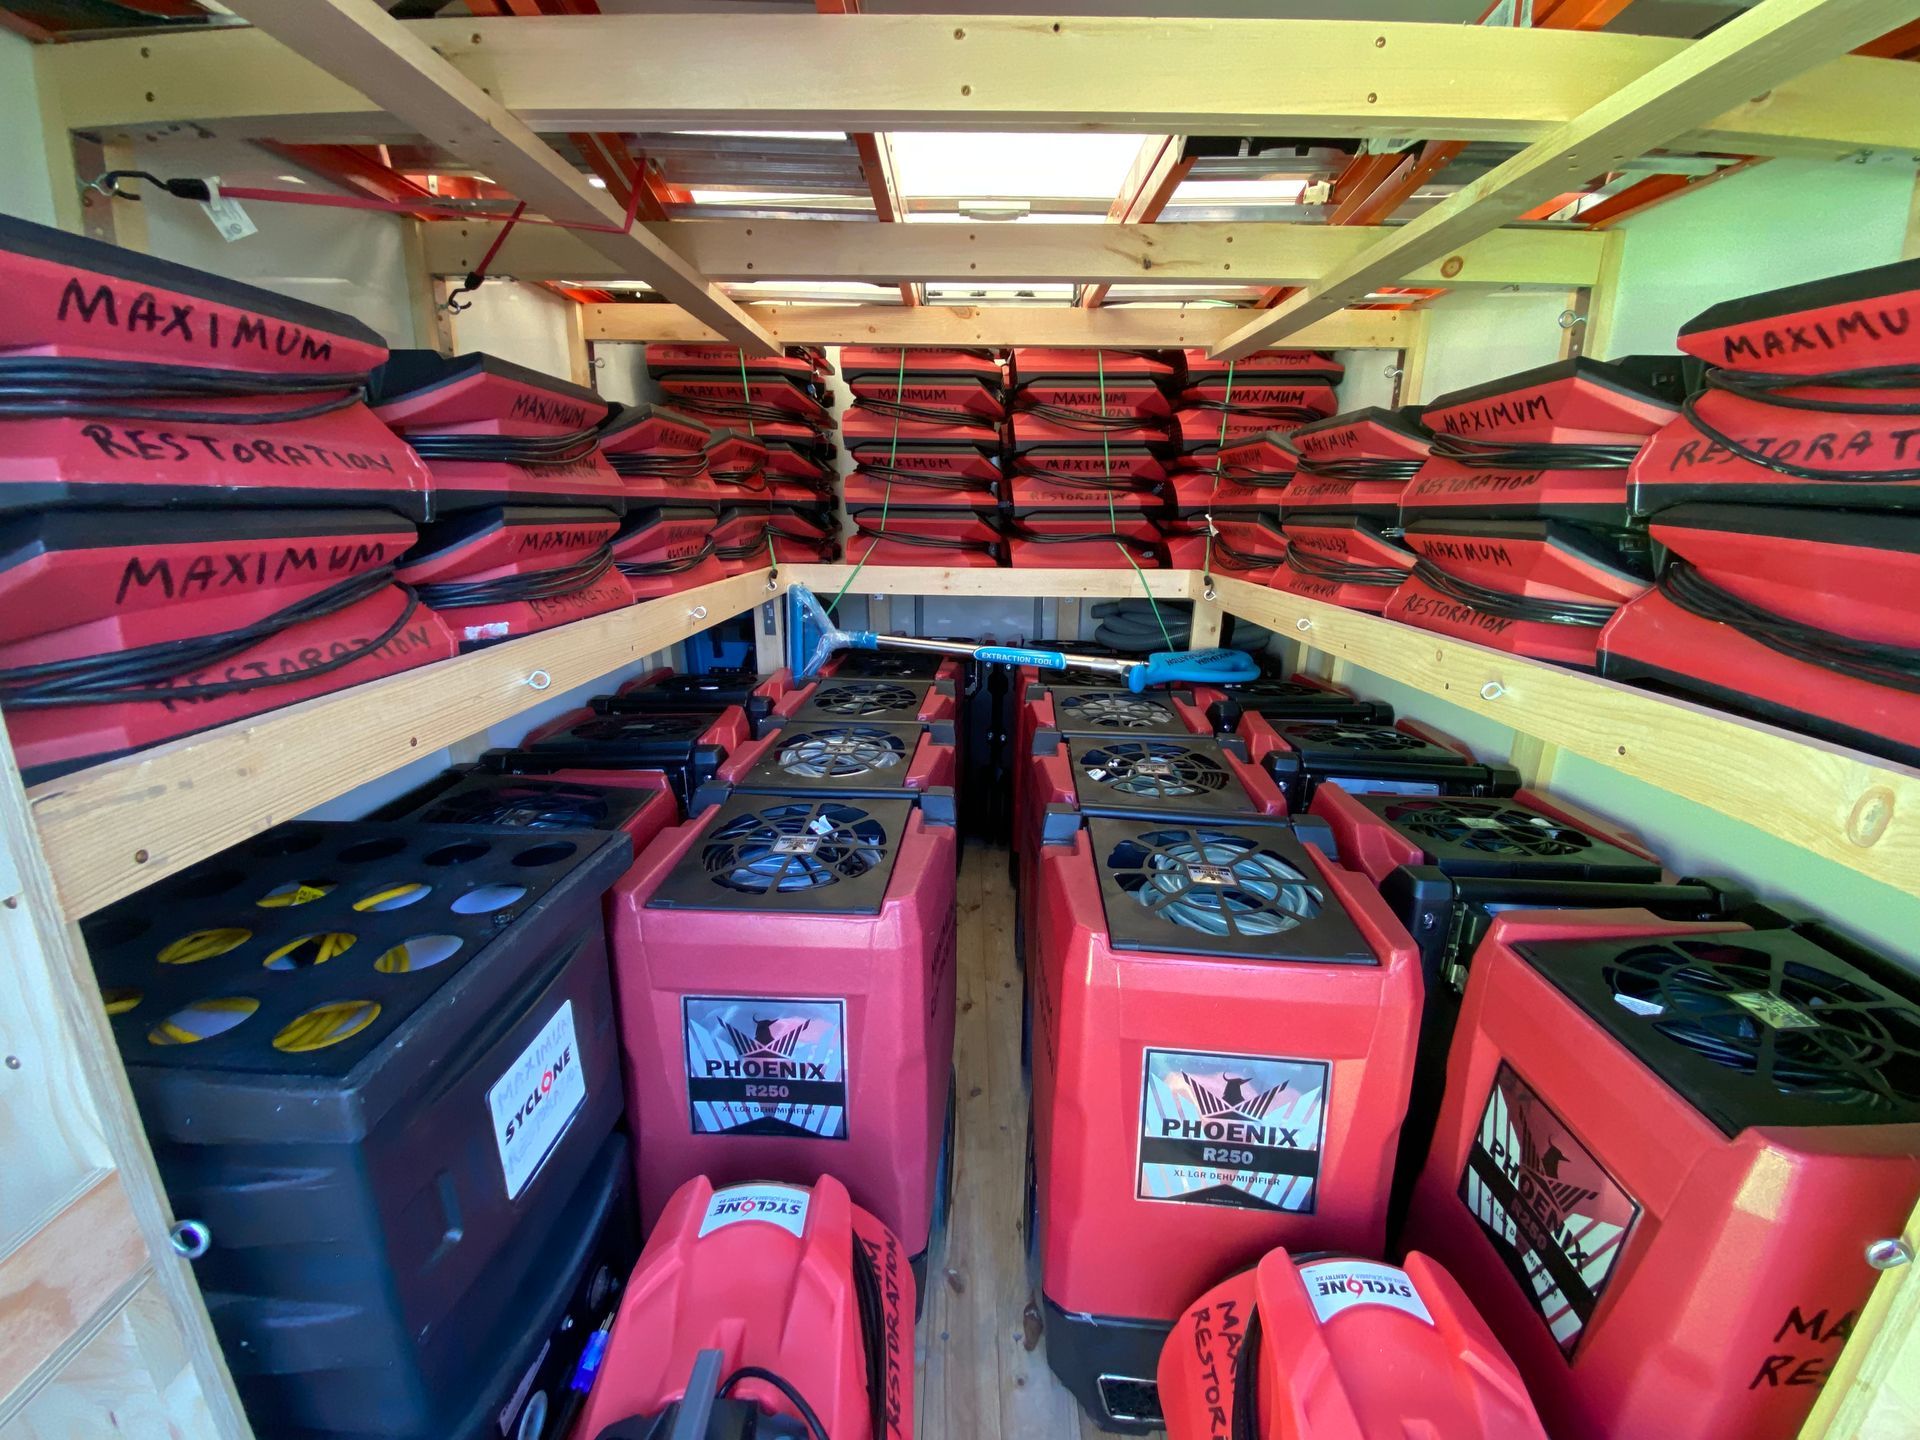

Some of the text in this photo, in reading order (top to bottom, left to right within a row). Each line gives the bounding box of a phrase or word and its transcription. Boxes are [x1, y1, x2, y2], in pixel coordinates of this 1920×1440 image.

[57, 278, 332, 361] MAXIMUM
[1724, 307, 1910, 363] MAXIMU
[878, 388, 947, 400] MAXIMUM
[1053, 391, 1127, 406] MAXIMUM
[1230, 390, 1305, 405] MAXIMUM
[1443, 395, 1553, 434] MAXIMUM
[82, 424, 395, 474] RESTORATION
[1303, 430, 1359, 452] MAXIMUM
[1046, 460, 1130, 470] MAXIMUM
[1416, 470, 1545, 496] RESTORATION
[518, 529, 609, 552] MAXIMUM
[1423, 540, 1513, 567] MAXIMUM
[116, 543, 386, 604] MAXIMUM
[1402, 593, 1513, 635] RESTORATION
[981, 652, 1053, 665] EXTRACTION TOOL
[705, 1060, 826, 1080] PHOENIX
[505, 1044, 572, 1146] SYCLONE
[745, 1084, 790, 1098] R250
[1161, 1118, 1300, 1148] PHOENIX
[1202, 1147, 1254, 1165] R250
[1174, 1169, 1281, 1186] XL LGR DEHUMIDIFIER
[713, 1199, 802, 1216] SYCLONE
[1490, 1137, 1590, 1275] PHOENIX
[1317, 1276, 1412, 1299] SYCLONE
[883, 1229, 902, 1439] RESTORATION
[1191, 1307, 1229, 1440] RESTOR
